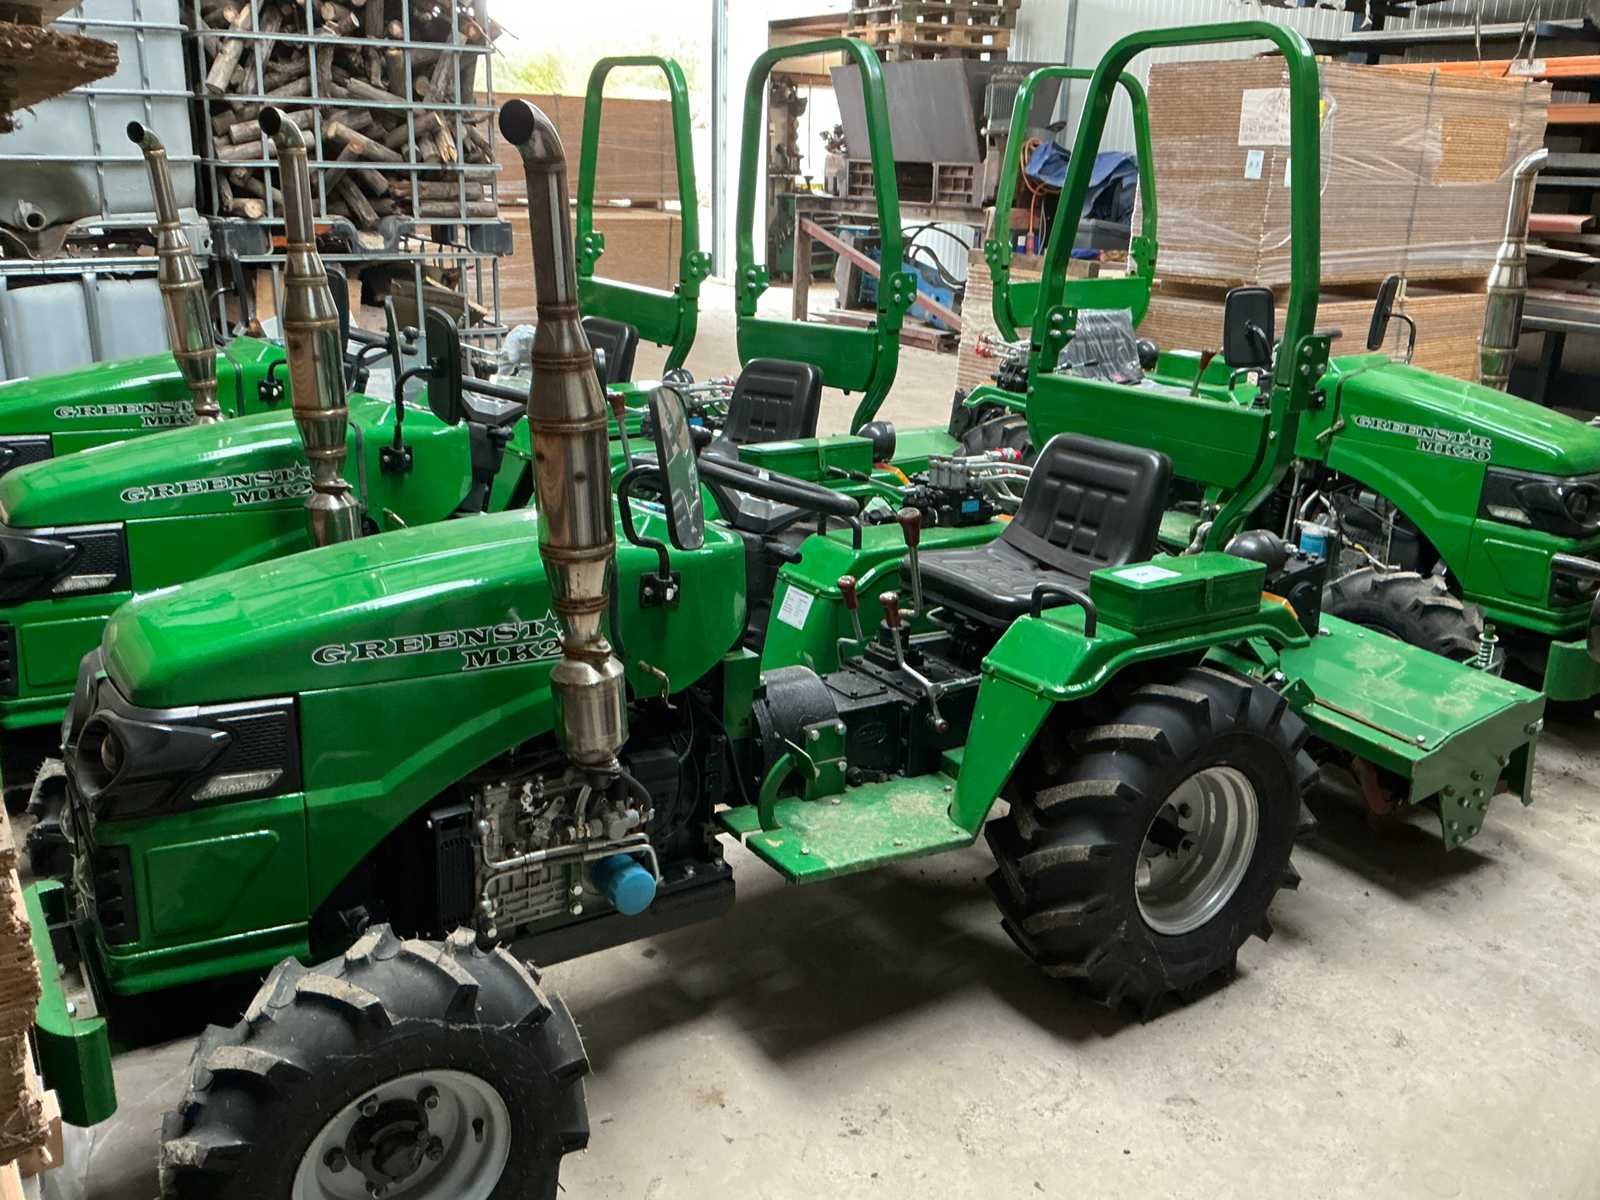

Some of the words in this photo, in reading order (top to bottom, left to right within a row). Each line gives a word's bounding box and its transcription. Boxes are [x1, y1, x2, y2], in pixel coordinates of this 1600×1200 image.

[1416, 438, 1491, 463] MK20
[233, 482, 314, 506] MK2
[462, 638, 565, 671] MK2
